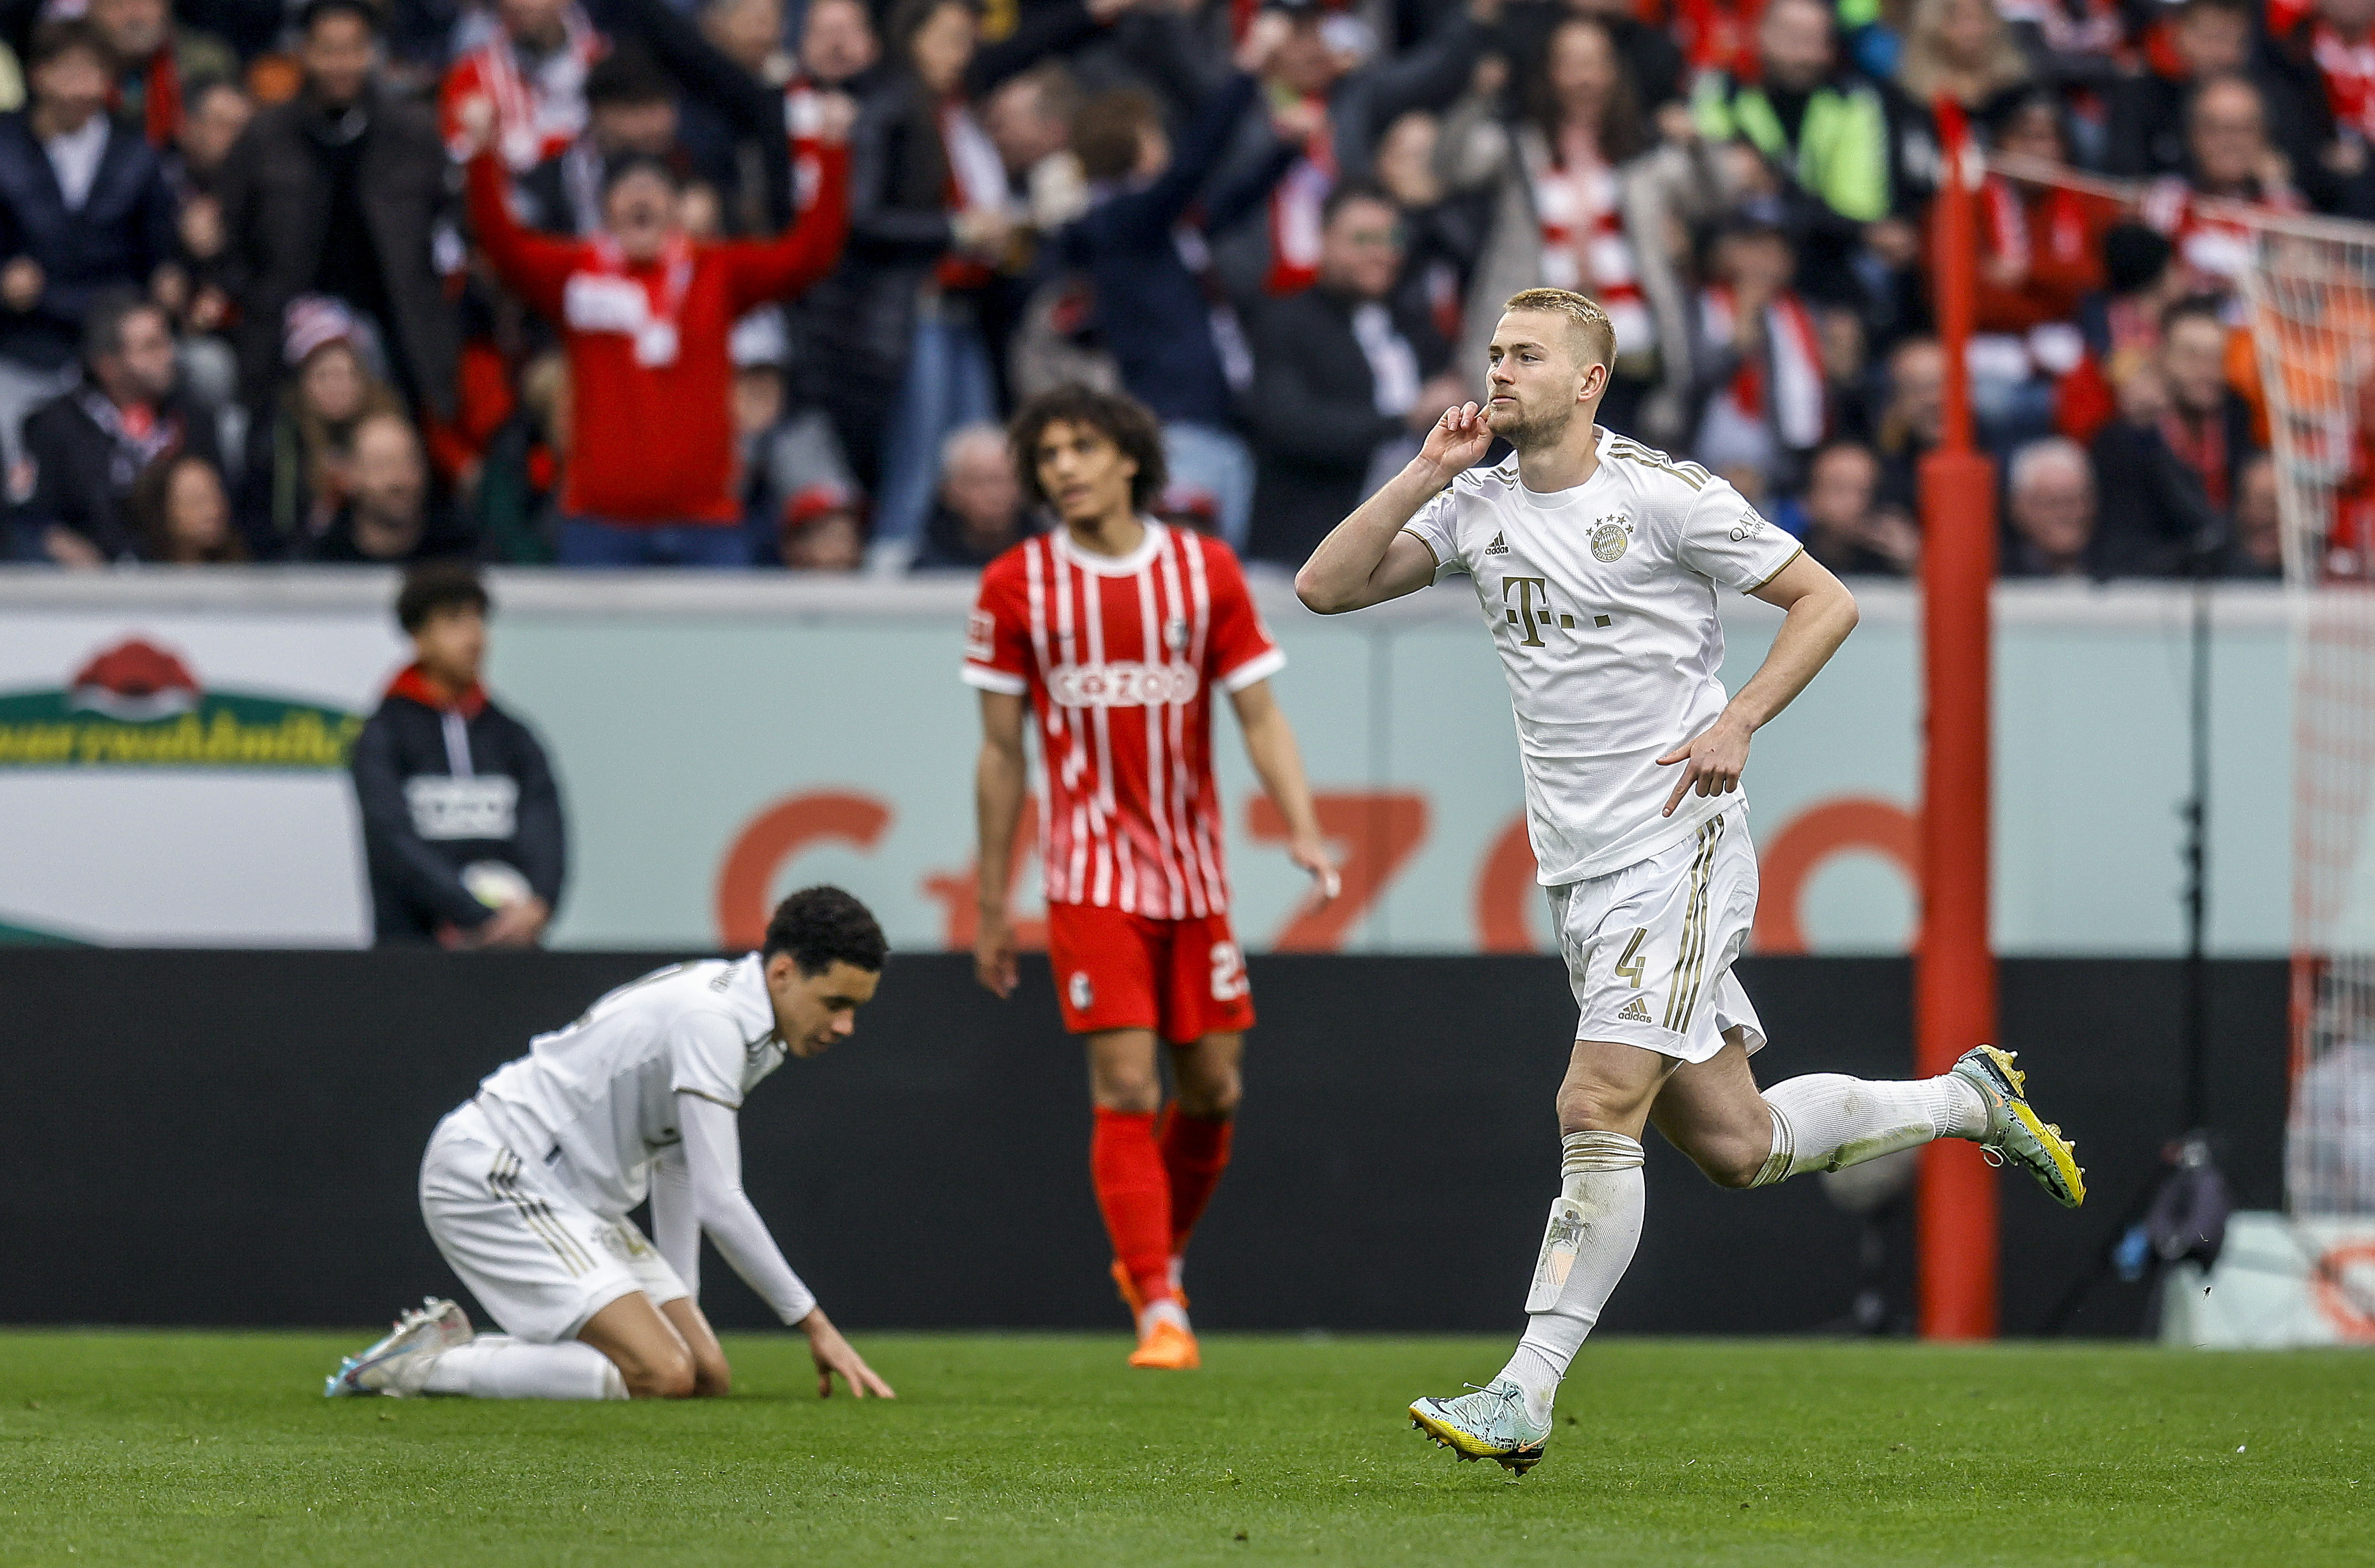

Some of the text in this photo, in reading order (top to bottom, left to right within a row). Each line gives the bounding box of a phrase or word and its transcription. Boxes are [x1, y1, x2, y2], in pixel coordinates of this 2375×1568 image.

[1485, 545, 1509, 555] addas
[1615, 927, 1647, 988] 4
[1618, 1012, 1652, 1024] adidas
